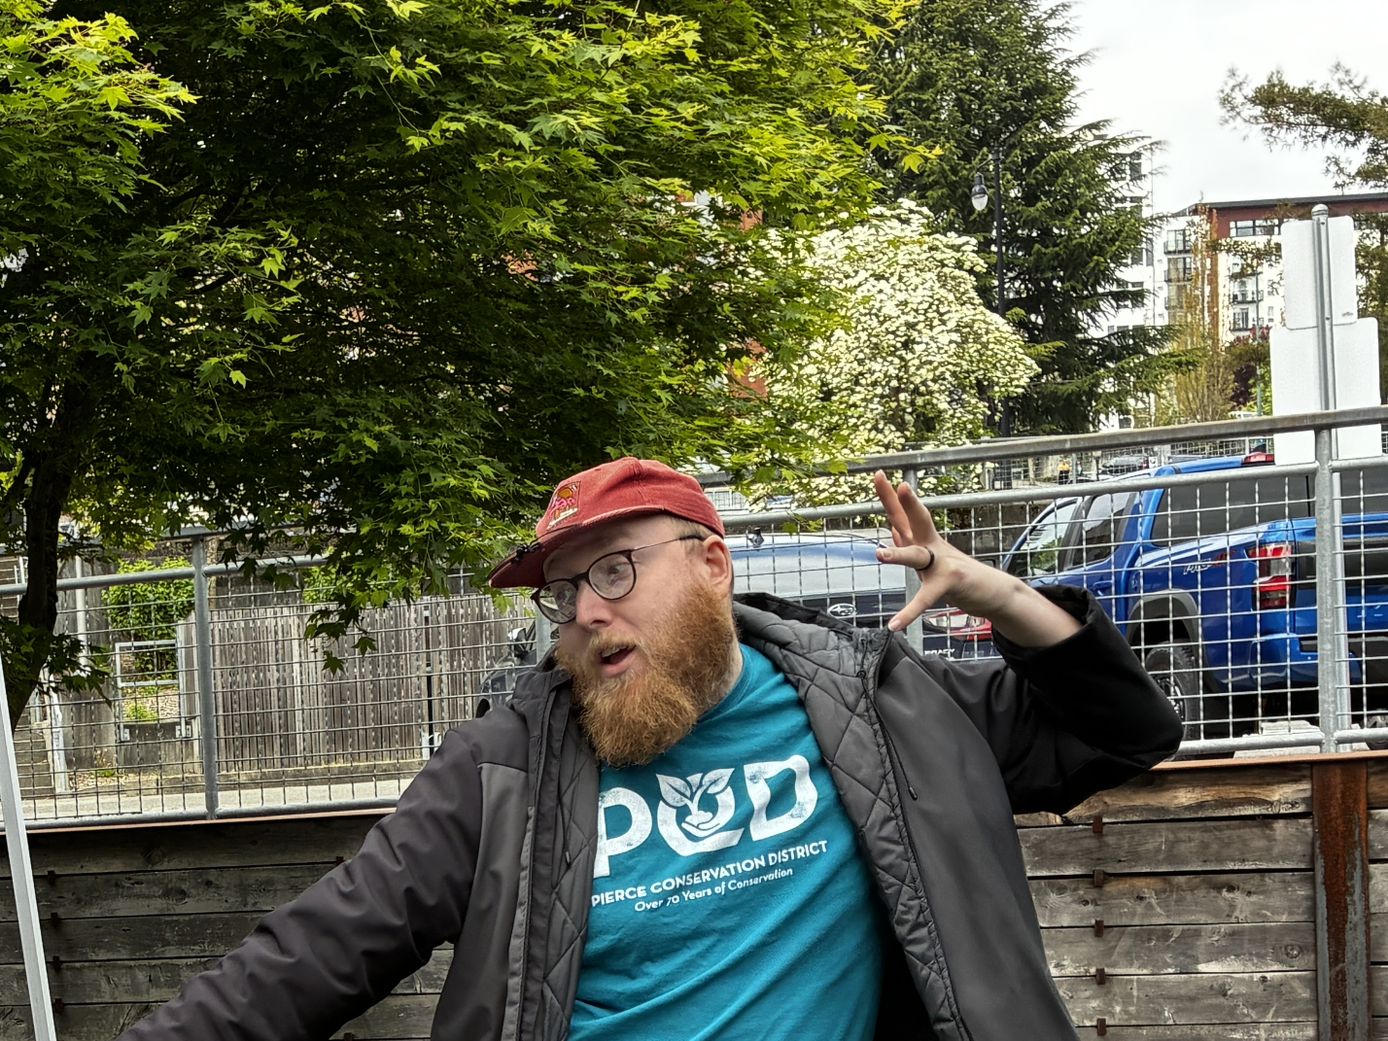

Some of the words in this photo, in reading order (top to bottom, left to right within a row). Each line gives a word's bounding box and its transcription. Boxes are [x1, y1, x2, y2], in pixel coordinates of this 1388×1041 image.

[591, 885, 648, 907] PIERCE
[650, 855, 766, 894] CONSERVATION
[768, 840, 828, 867] DISTRICT
[634, 899, 664, 912] Over
[666, 895, 680, 907] 70
[682, 880, 713, 901] Years
[714, 881, 726, 895] of
[728, 867, 794, 890] Conservation
